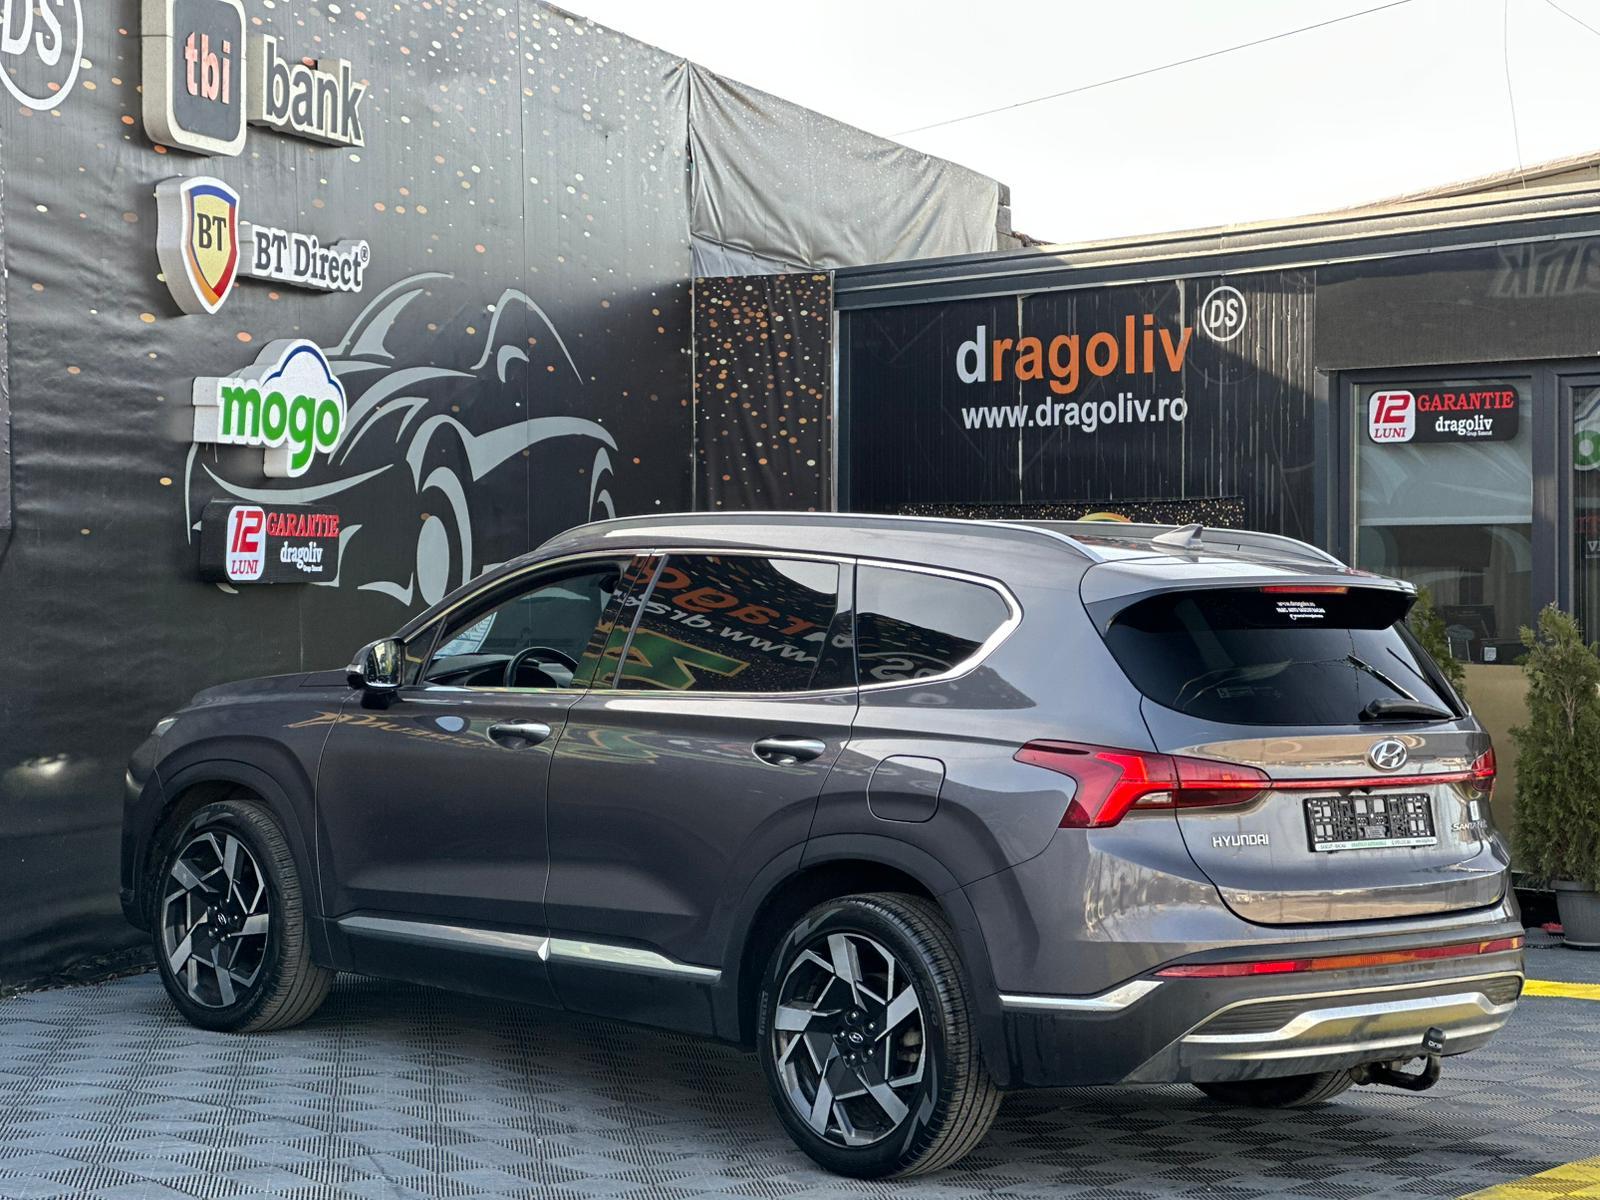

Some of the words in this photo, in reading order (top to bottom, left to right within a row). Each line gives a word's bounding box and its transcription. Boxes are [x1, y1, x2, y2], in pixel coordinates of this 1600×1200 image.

[184, 31, 231, 105] tbi
[264, 36, 365, 147] bank
[197, 213, 227, 252] BT
[255, 230, 288, 273] BT
[1209, 298, 1239, 328] DS
[956, 313, 1193, 395] dragoliv
[961, 392, 1189, 433] www.dragoliv.ro
[1373, 394, 1411, 425] 12
[1417, 391, 1514, 412] GARANTIE
[221, 385, 340, 470] mogo
[1374, 427, 1407, 439] LUNI
[1435, 415, 1493, 436] dragoliv
[231, 510, 263, 553] 12
[266, 511, 339, 538] GARANTIE
[231, 559, 259, 575] LUNI
[280, 540, 323, 569] dragoliv
[1212, 833, 1269, 848] HYUNDAI
